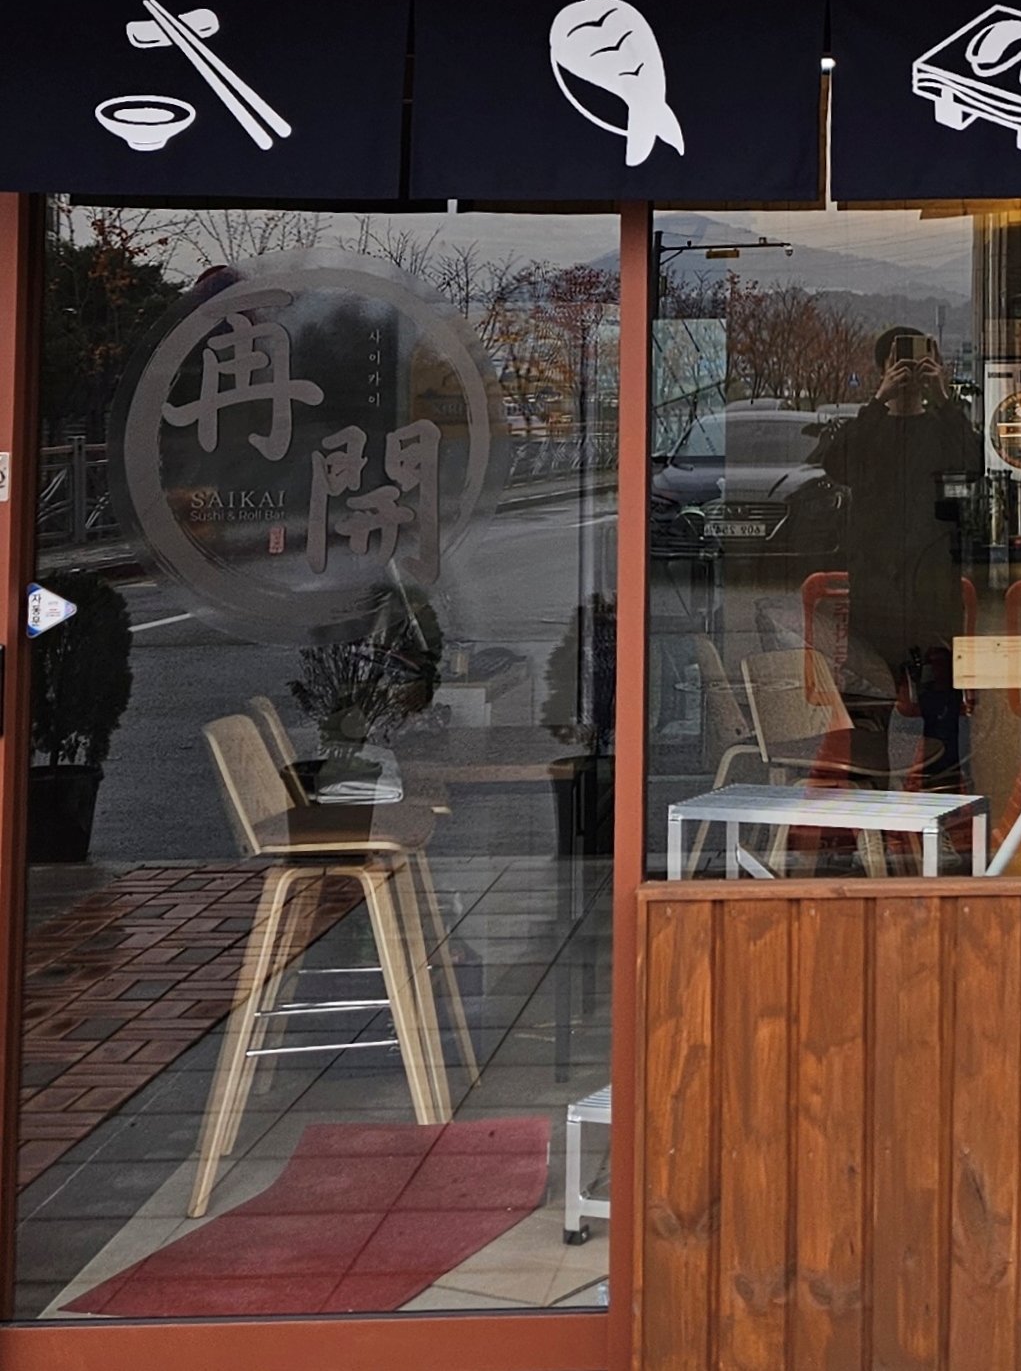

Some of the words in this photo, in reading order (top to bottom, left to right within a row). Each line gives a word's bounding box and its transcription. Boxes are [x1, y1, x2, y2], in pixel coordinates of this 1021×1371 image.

[190, 490, 285, 509] SAIKAI
[190, 509, 225, 522] Sushi
[239, 510, 262, 521] Roll
[265, 510, 285, 521] Bar
